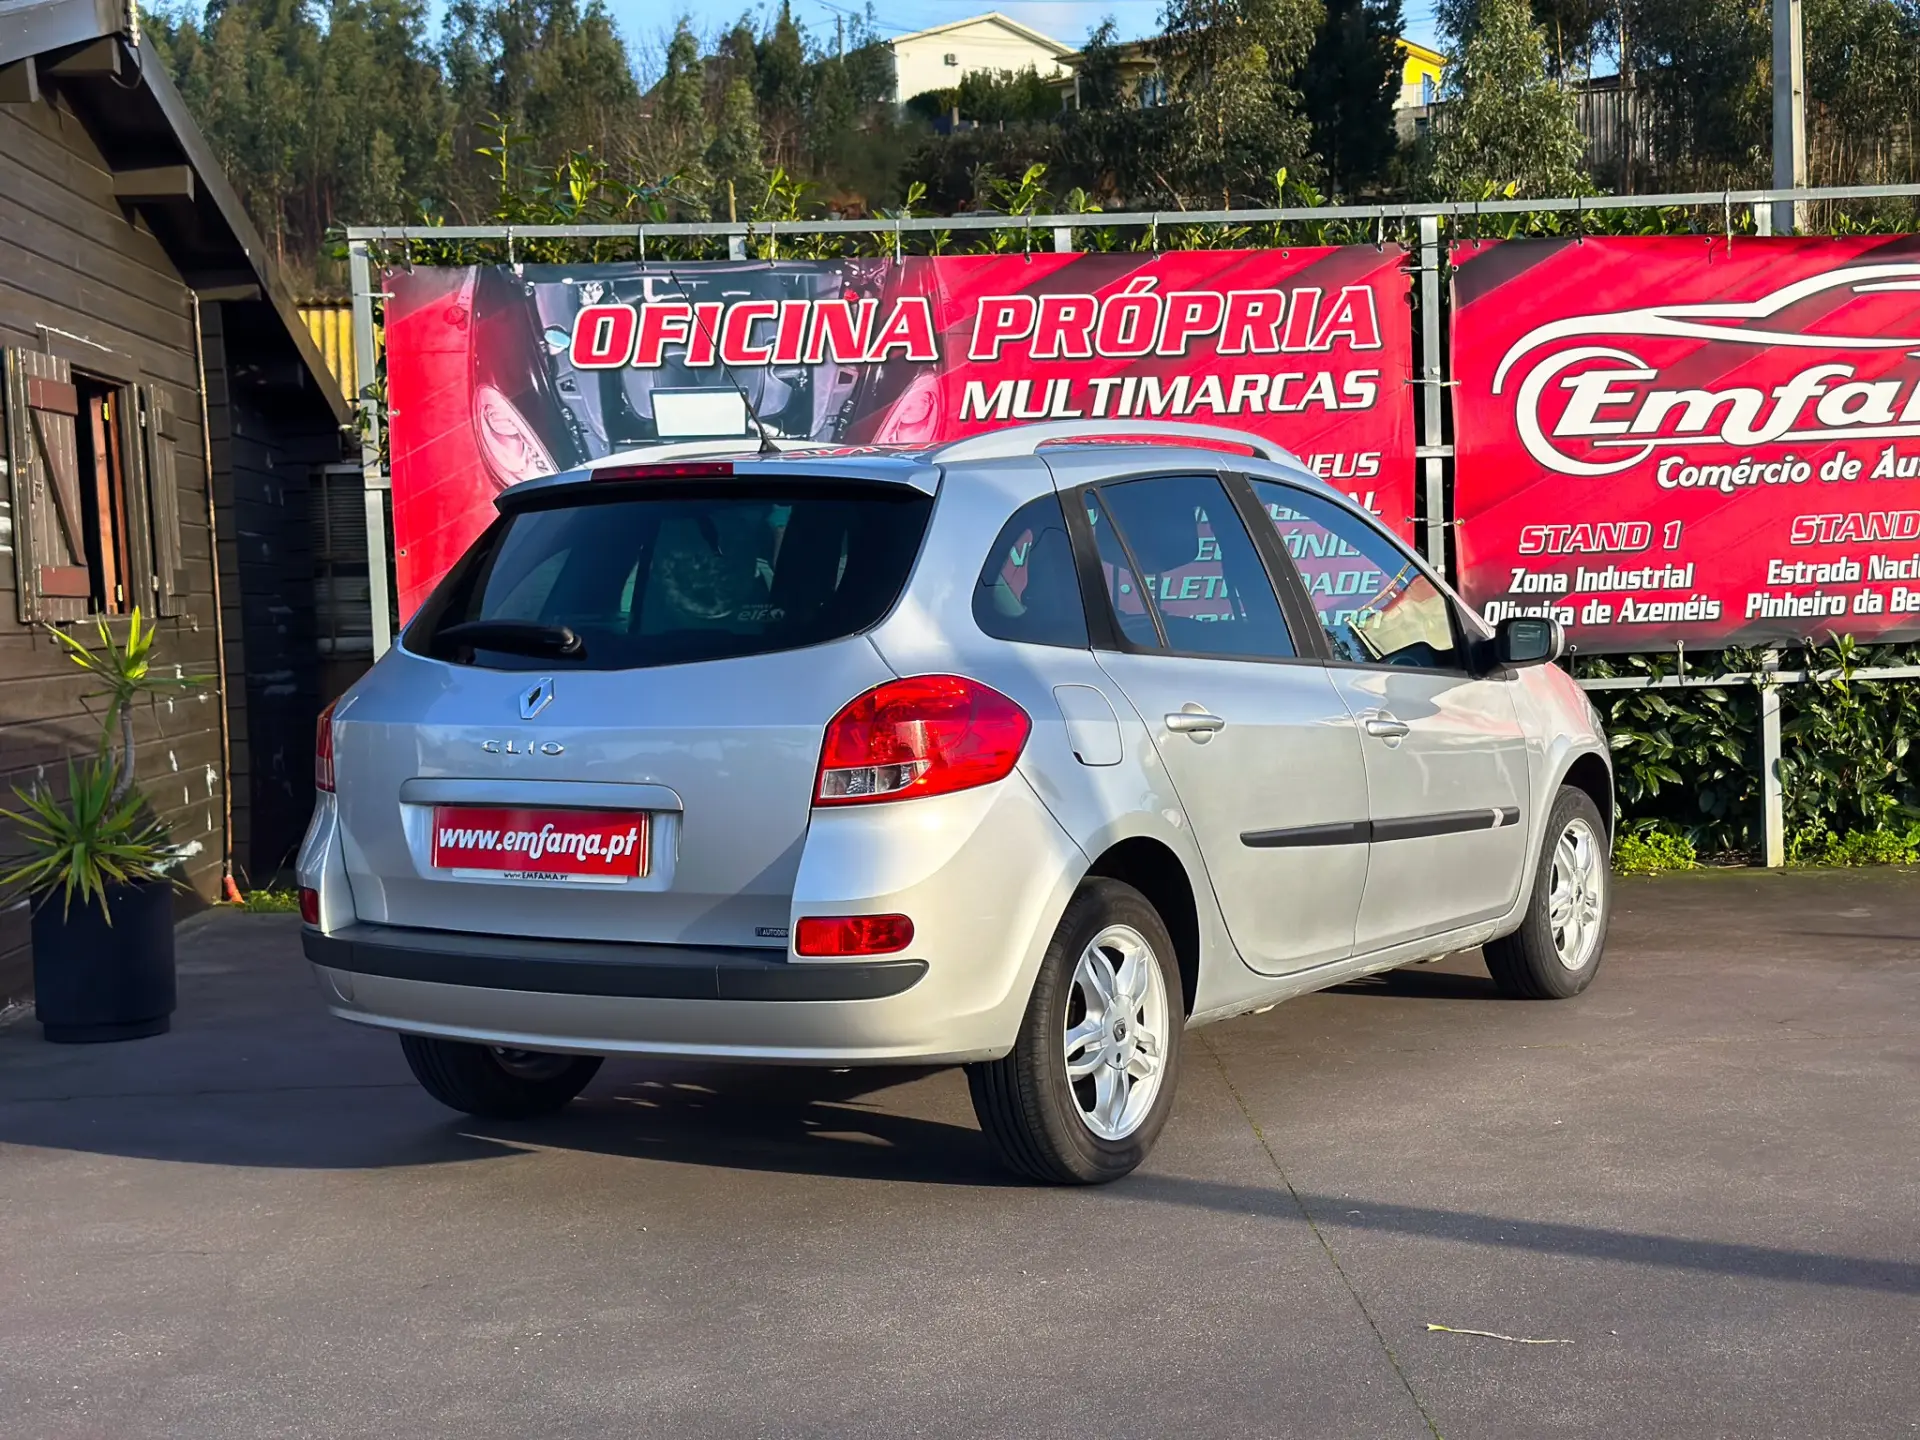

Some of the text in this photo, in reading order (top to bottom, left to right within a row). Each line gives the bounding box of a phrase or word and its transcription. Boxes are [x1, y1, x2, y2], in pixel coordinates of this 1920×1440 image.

[569, 276, 1382, 369] OFICINA PRÓPRIA
[959, 369, 1380, 421] MULTIMARCAS
[1656, 455, 1812, 493] Comércio
[1819, 451, 1862, 482] de
[1518, 520, 1682, 554] STAND 1
[1790, 510, 1920, 544] STAND
[1508, 562, 1694, 594] Zona Industrial
[1766, 556, 1861, 585] Estrada
[1581, 599, 1612, 625] de
[1617, 594, 1722, 623] Azeméis
[1745, 590, 1847, 619] Pinheiro
[1853, 588, 1883, 614] da
[481, 740, 565, 756] CLIO
[439, 823, 638, 864] www.emfama.pt
